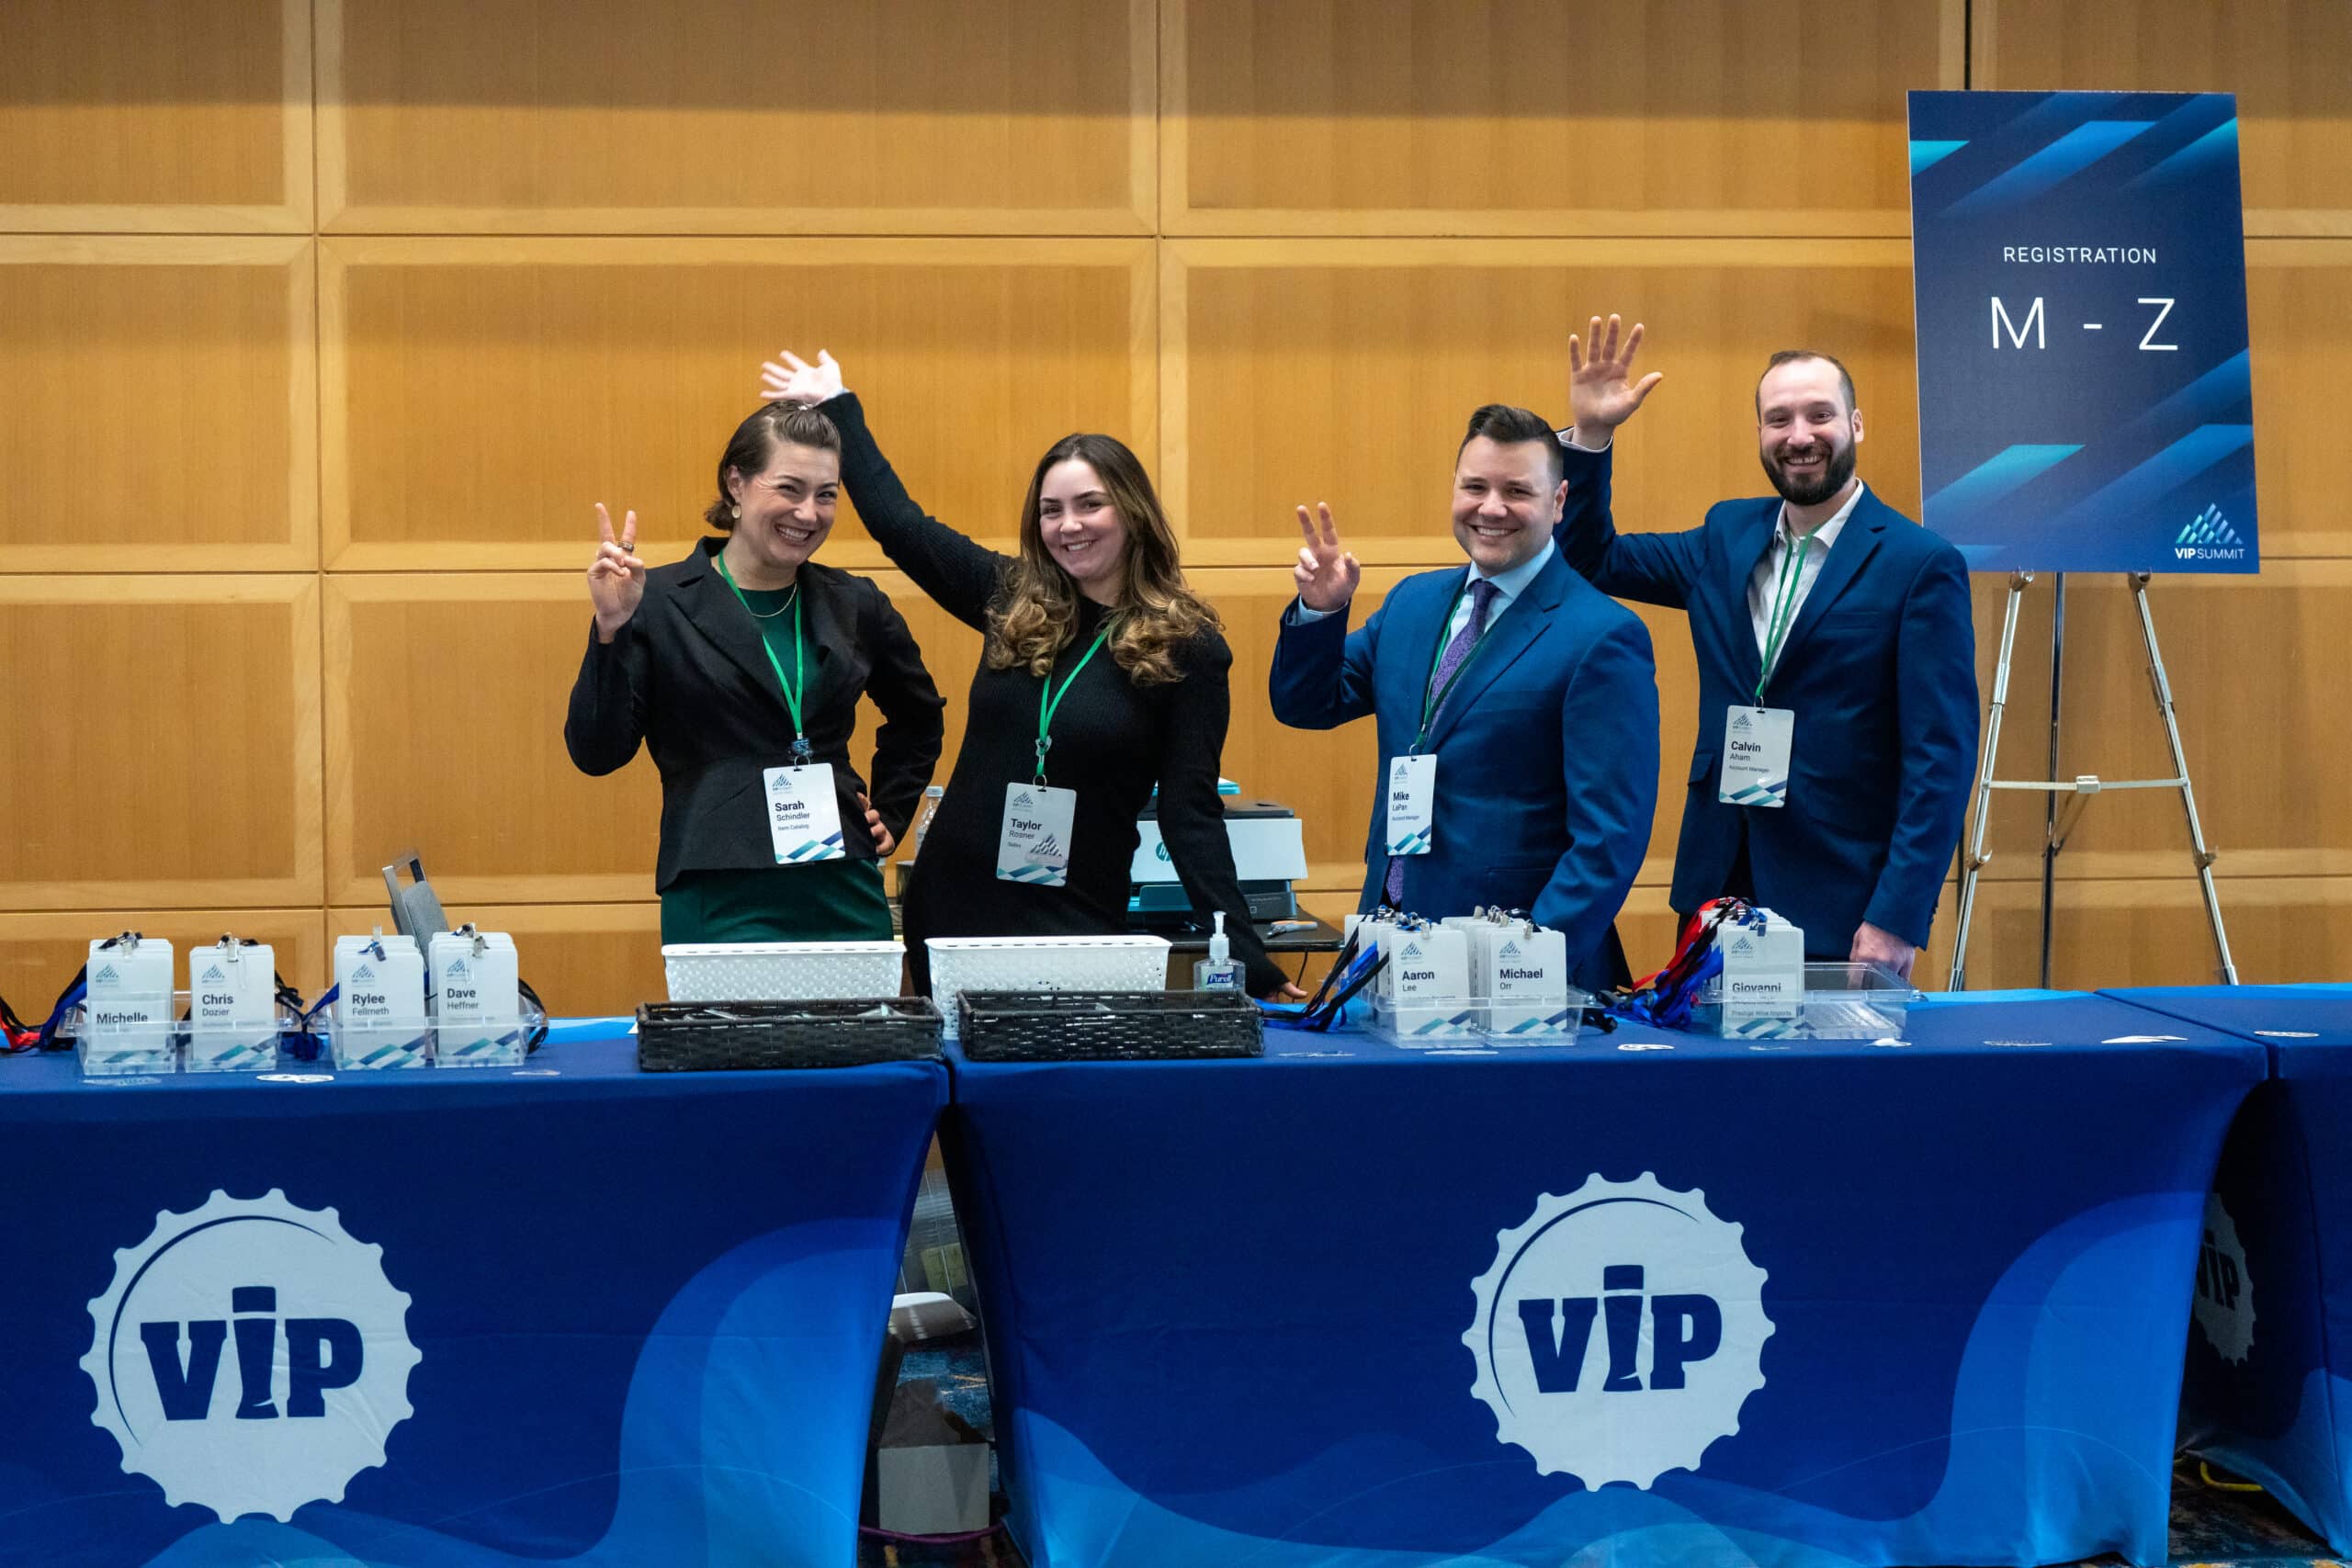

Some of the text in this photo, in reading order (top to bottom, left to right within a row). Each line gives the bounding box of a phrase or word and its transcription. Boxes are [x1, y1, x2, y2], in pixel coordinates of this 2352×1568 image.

[2003, 246, 2157, 265] REGISTRATION
[1990, 296, 2046, 350] M
[2137, 298, 2178, 351] Z
[1731, 741, 1761, 752] Calvin
[1393, 792, 1409, 801] Mike
[775, 801, 805, 811] Sarah
[776, 812, 809, 821] Schindler
[1011, 818, 1042, 830] Taylor
[1402, 970, 1435, 981] Aaron
[1499, 968, 1544, 979] Michael
[1402, 984, 1417, 992] Lee
[1499, 982, 1512, 991] Orr
[1732, 982, 1781, 993] Giovanni
[447, 988, 476, 998] Dave
[202, 994, 234, 1005] Chris
[352, 994, 386, 1007] Rylee
[447, 1000, 479, 1010] Heffner
[96, 1012, 148, 1024] Michelle
[202, 1008, 230, 1017] Dozier
